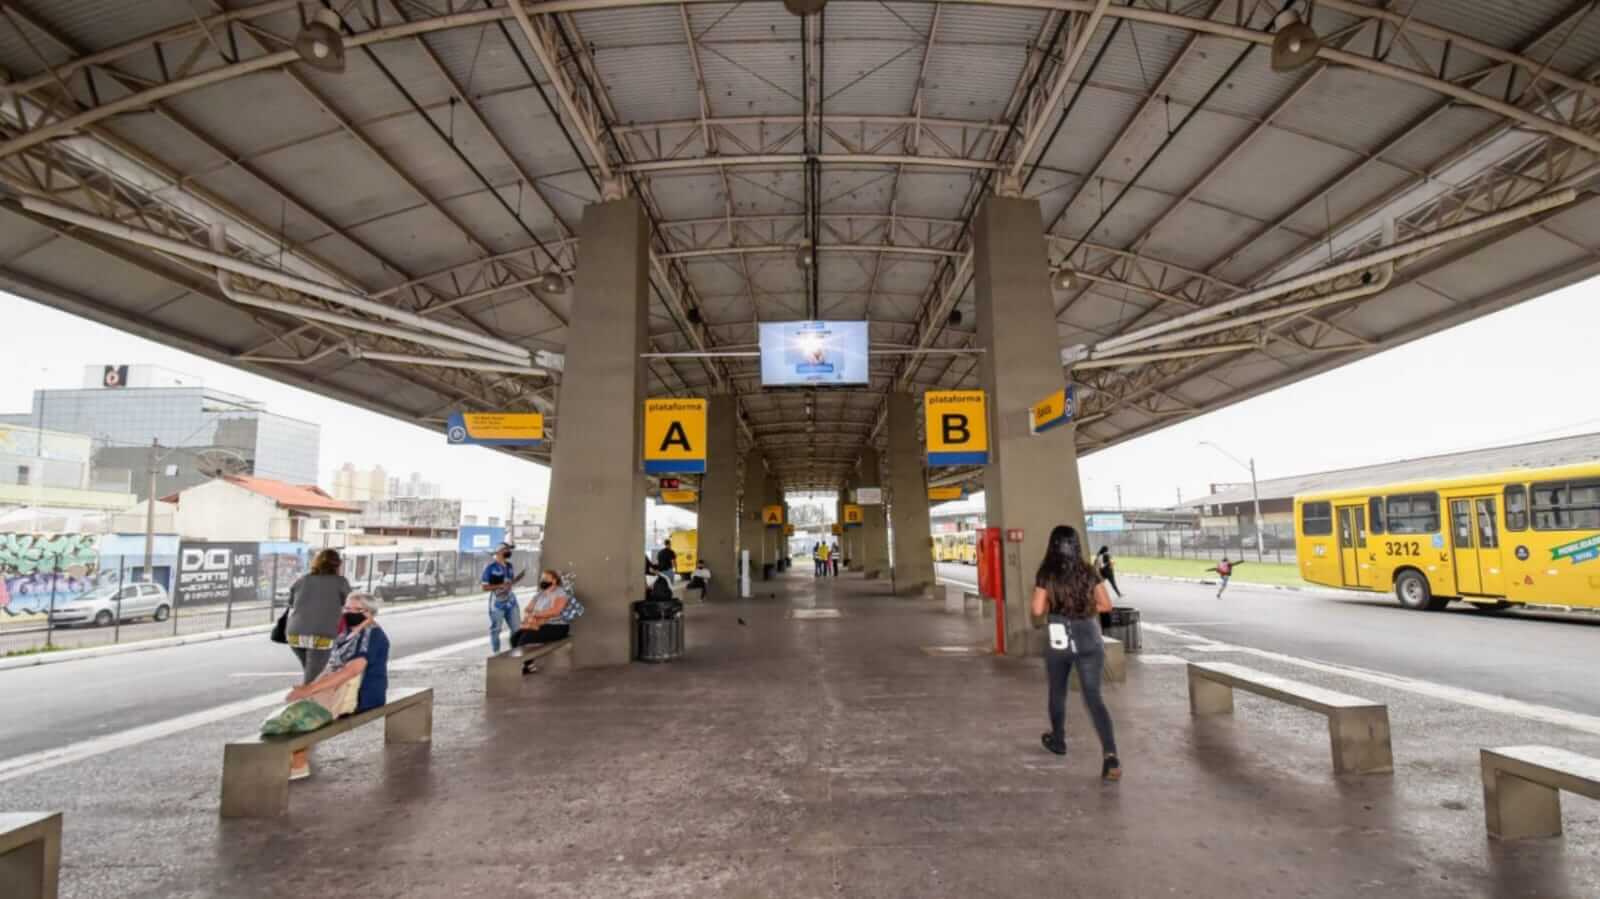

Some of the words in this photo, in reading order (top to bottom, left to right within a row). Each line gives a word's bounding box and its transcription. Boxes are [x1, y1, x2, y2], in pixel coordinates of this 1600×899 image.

[648, 402, 702, 412] plataforma
[928, 394, 981, 405] plataforma
[660, 420, 692, 452] A
[941, 413, 971, 444] B
[1385, 541, 1420, 556] 3212
